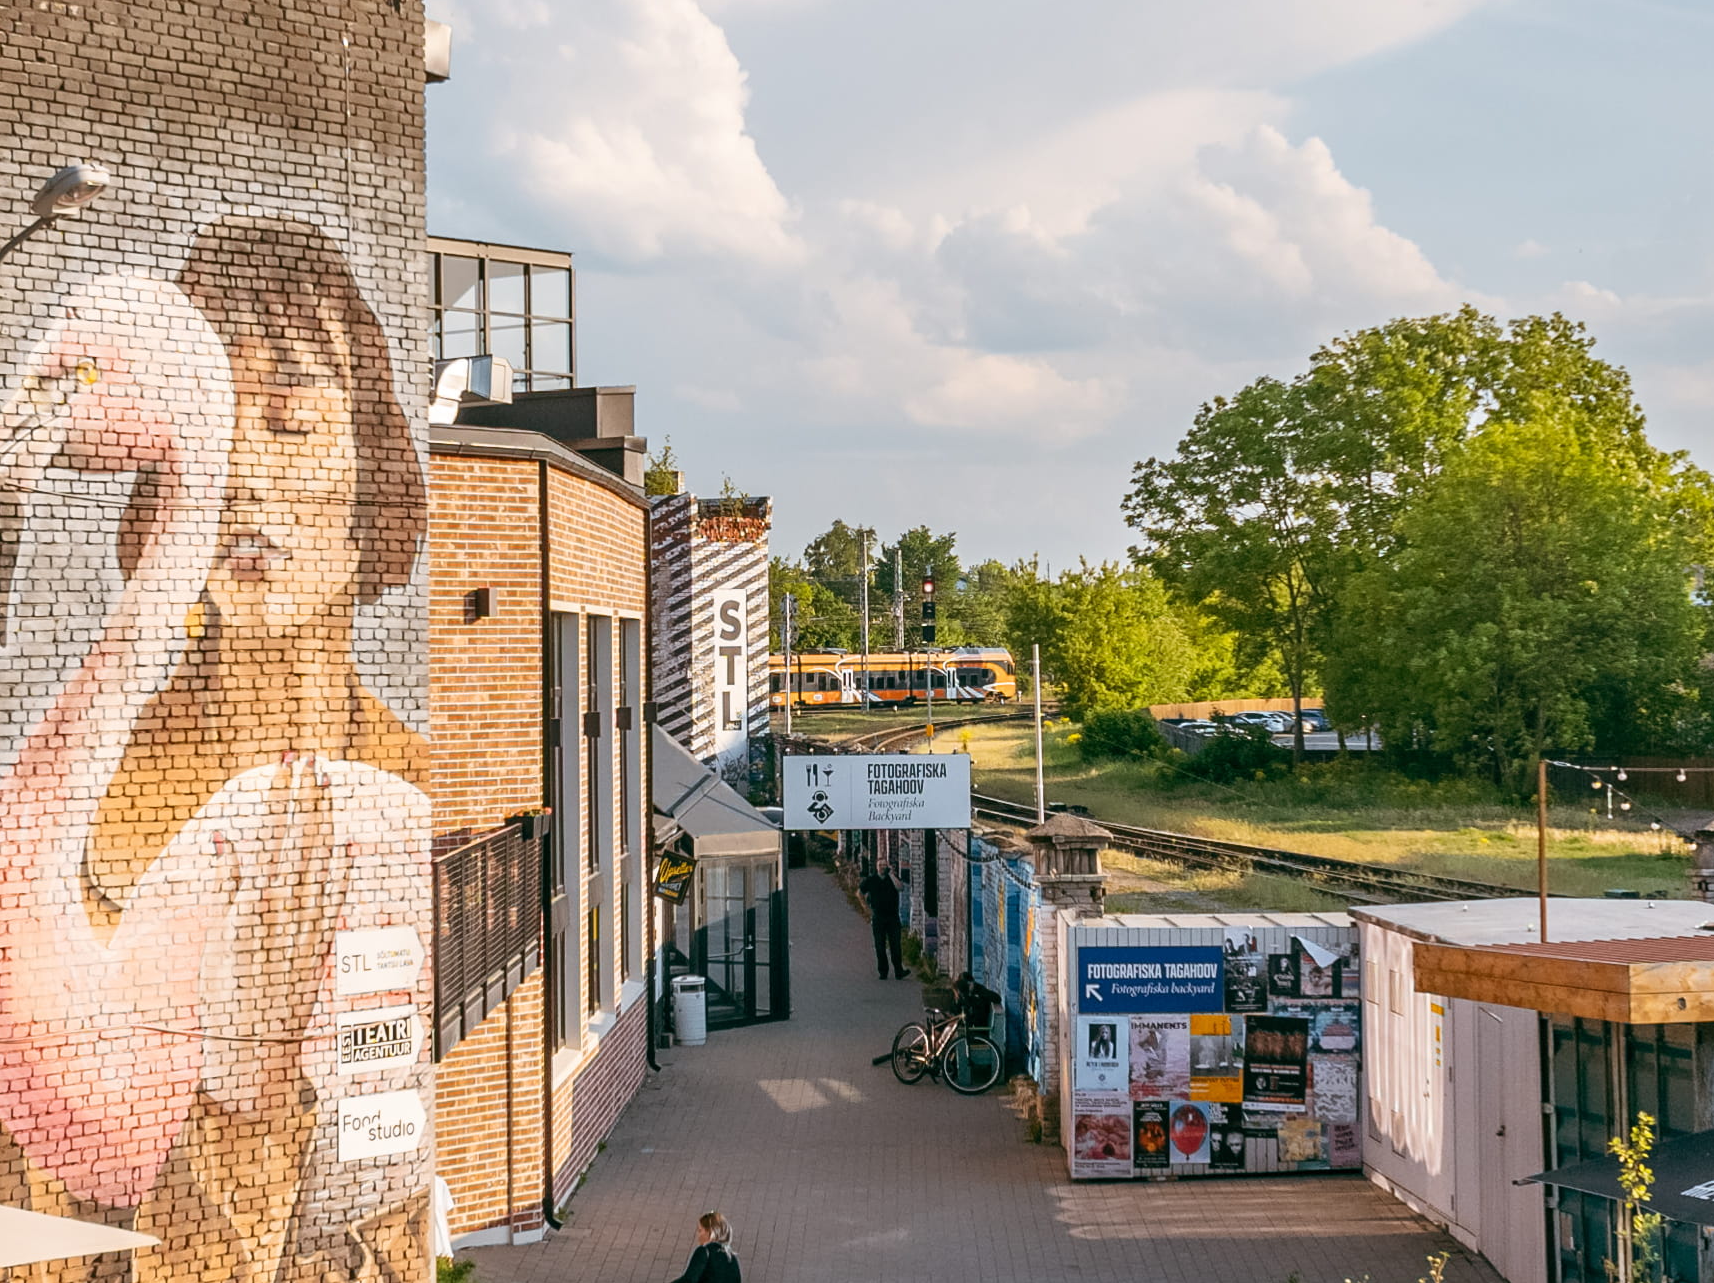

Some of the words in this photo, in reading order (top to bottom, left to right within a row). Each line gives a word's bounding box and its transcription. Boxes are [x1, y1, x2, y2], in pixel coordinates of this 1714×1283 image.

[719, 600, 742, 731] STL
[867, 763, 947, 779] FOTOGRAFISKA
[868, 779, 924, 795] TAGAHOOV
[868, 797, 925, 810] Fotografiska
[868, 809, 912, 823] Backyard
[341, 954, 372, 973] STL
[1087, 963, 1162, 979] FOTOGRAFISKA
[1164, 963, 1218, 979] TAGAHOOV
[1111, 983, 1169, 997] Fotografiska
[1171, 983, 1215, 997] backyard
[355, 1018, 411, 1045] TEATRI
[341, 1025, 352, 1063] EESTI
[354, 1042, 411, 1062] AGENTUUR
[368, 1119, 415, 1141] studio
